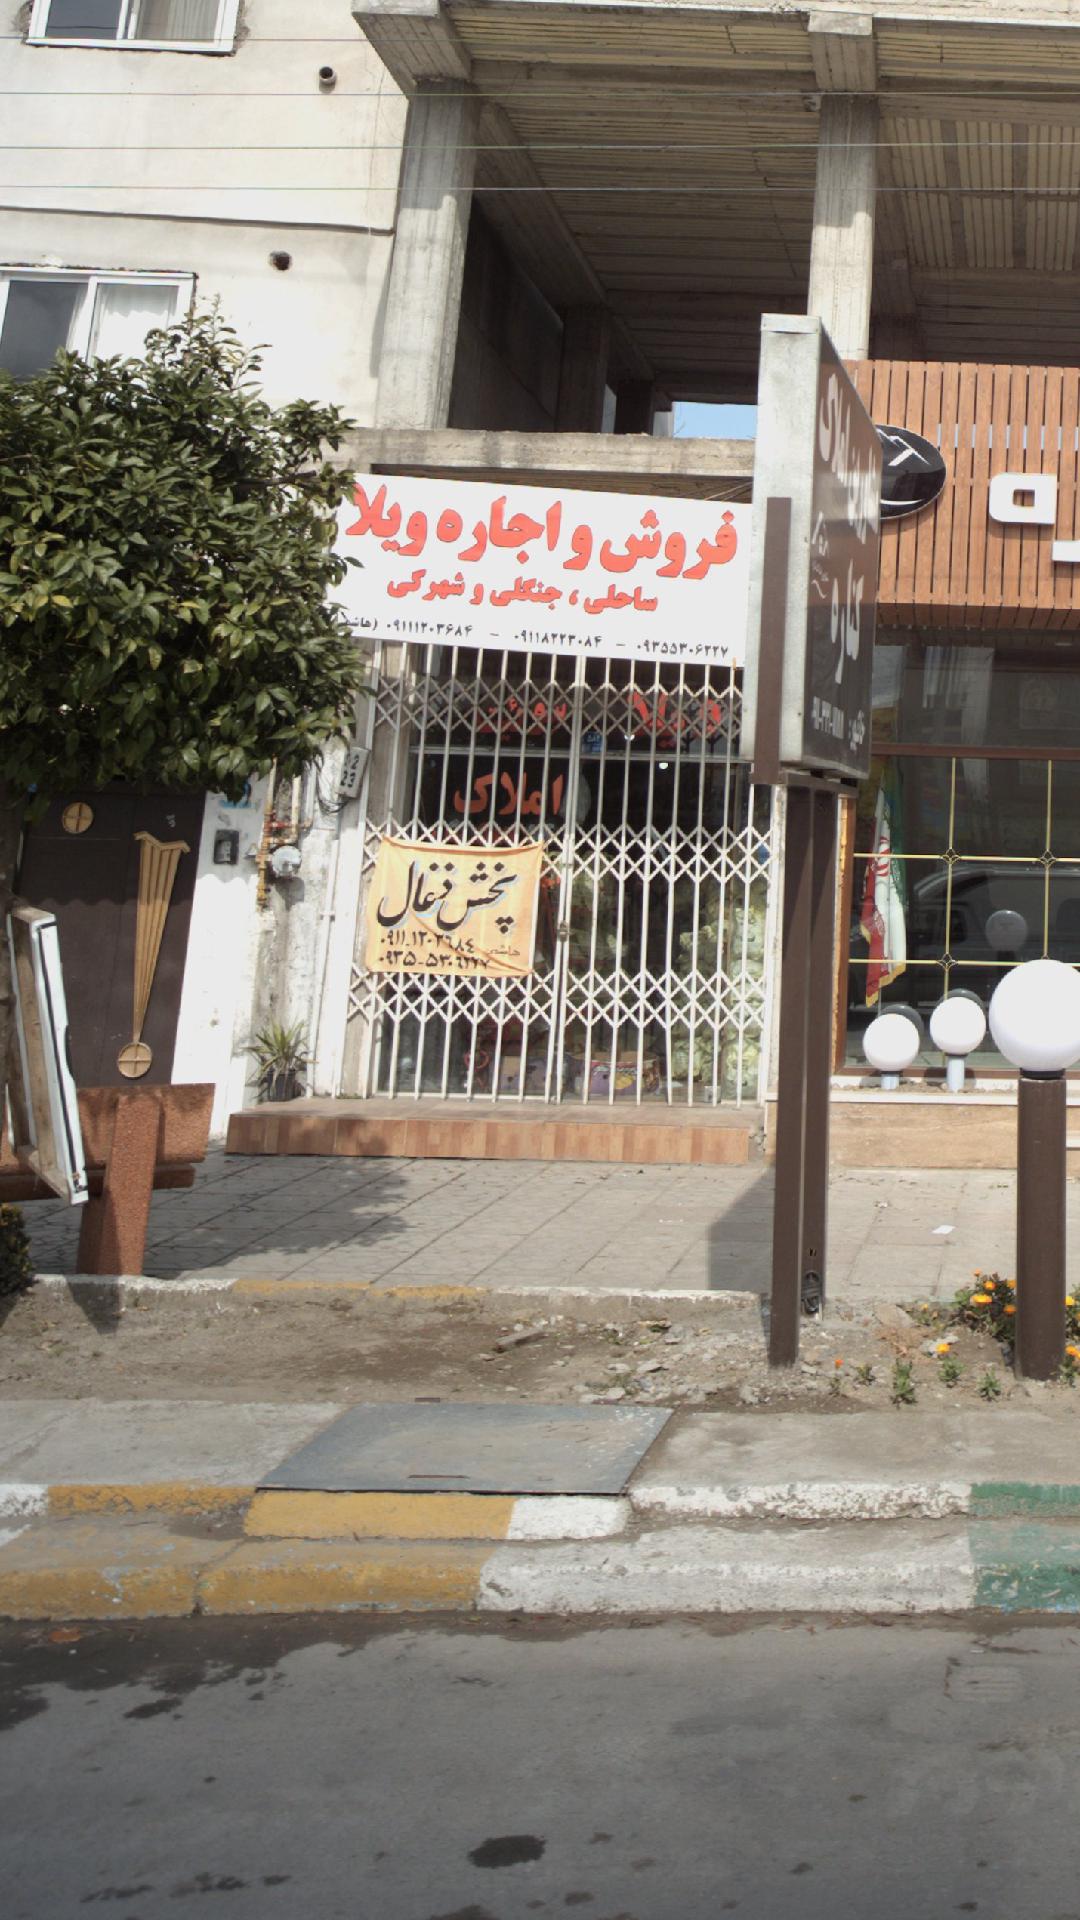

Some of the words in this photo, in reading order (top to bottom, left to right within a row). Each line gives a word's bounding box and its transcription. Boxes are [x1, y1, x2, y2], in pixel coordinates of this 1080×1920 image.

[345, 482, 428, 558] ویلا
[435, 495, 562, 565] اجاره
[562, 524, 594, 572] و
[598, 509, 739, 581] فروش
[469, 583, 485, 606] و
[489, 575, 564, 610] جنگلی
[453, 771, 565, 816] املاک
[436, 861, 518, 934] پخش
